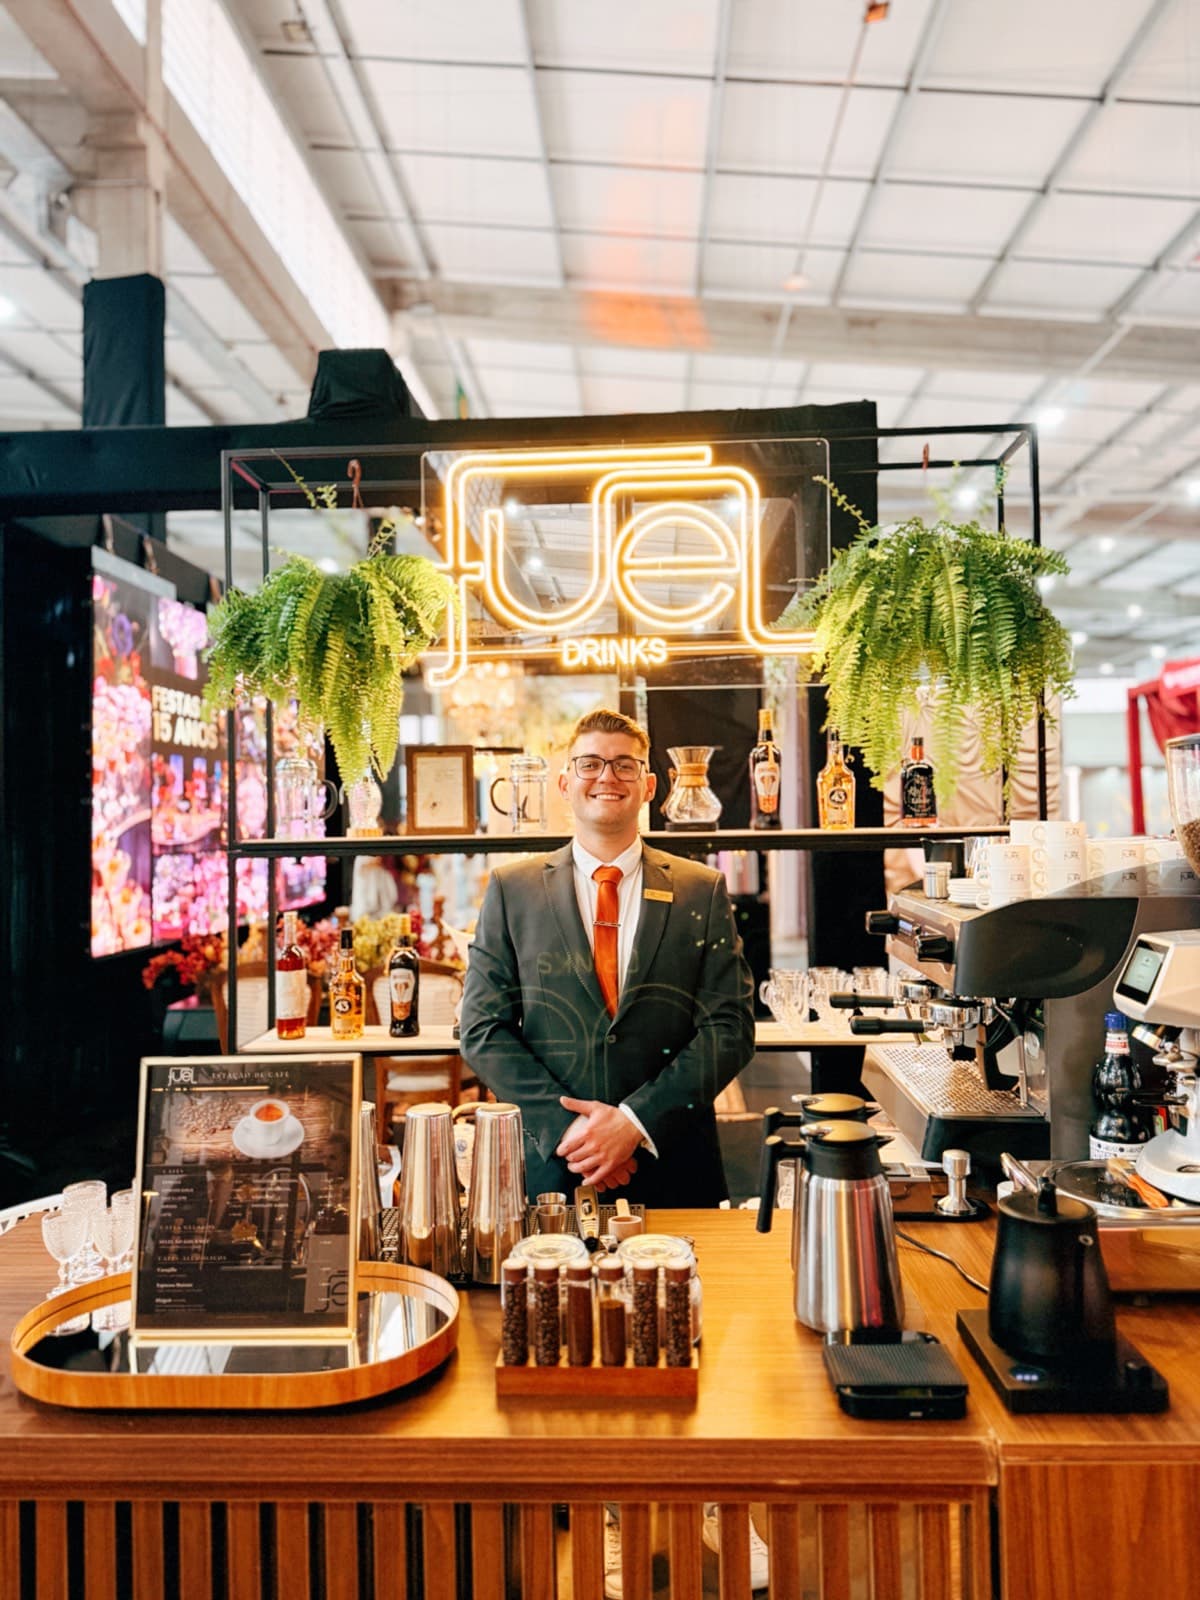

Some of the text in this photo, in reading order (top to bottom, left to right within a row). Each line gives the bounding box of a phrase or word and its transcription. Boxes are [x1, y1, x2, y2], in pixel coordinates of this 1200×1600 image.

[561, 638, 669, 667] DRINKS
[153, 709, 172, 743] 15
[174, 716, 218, 749] ANOS
